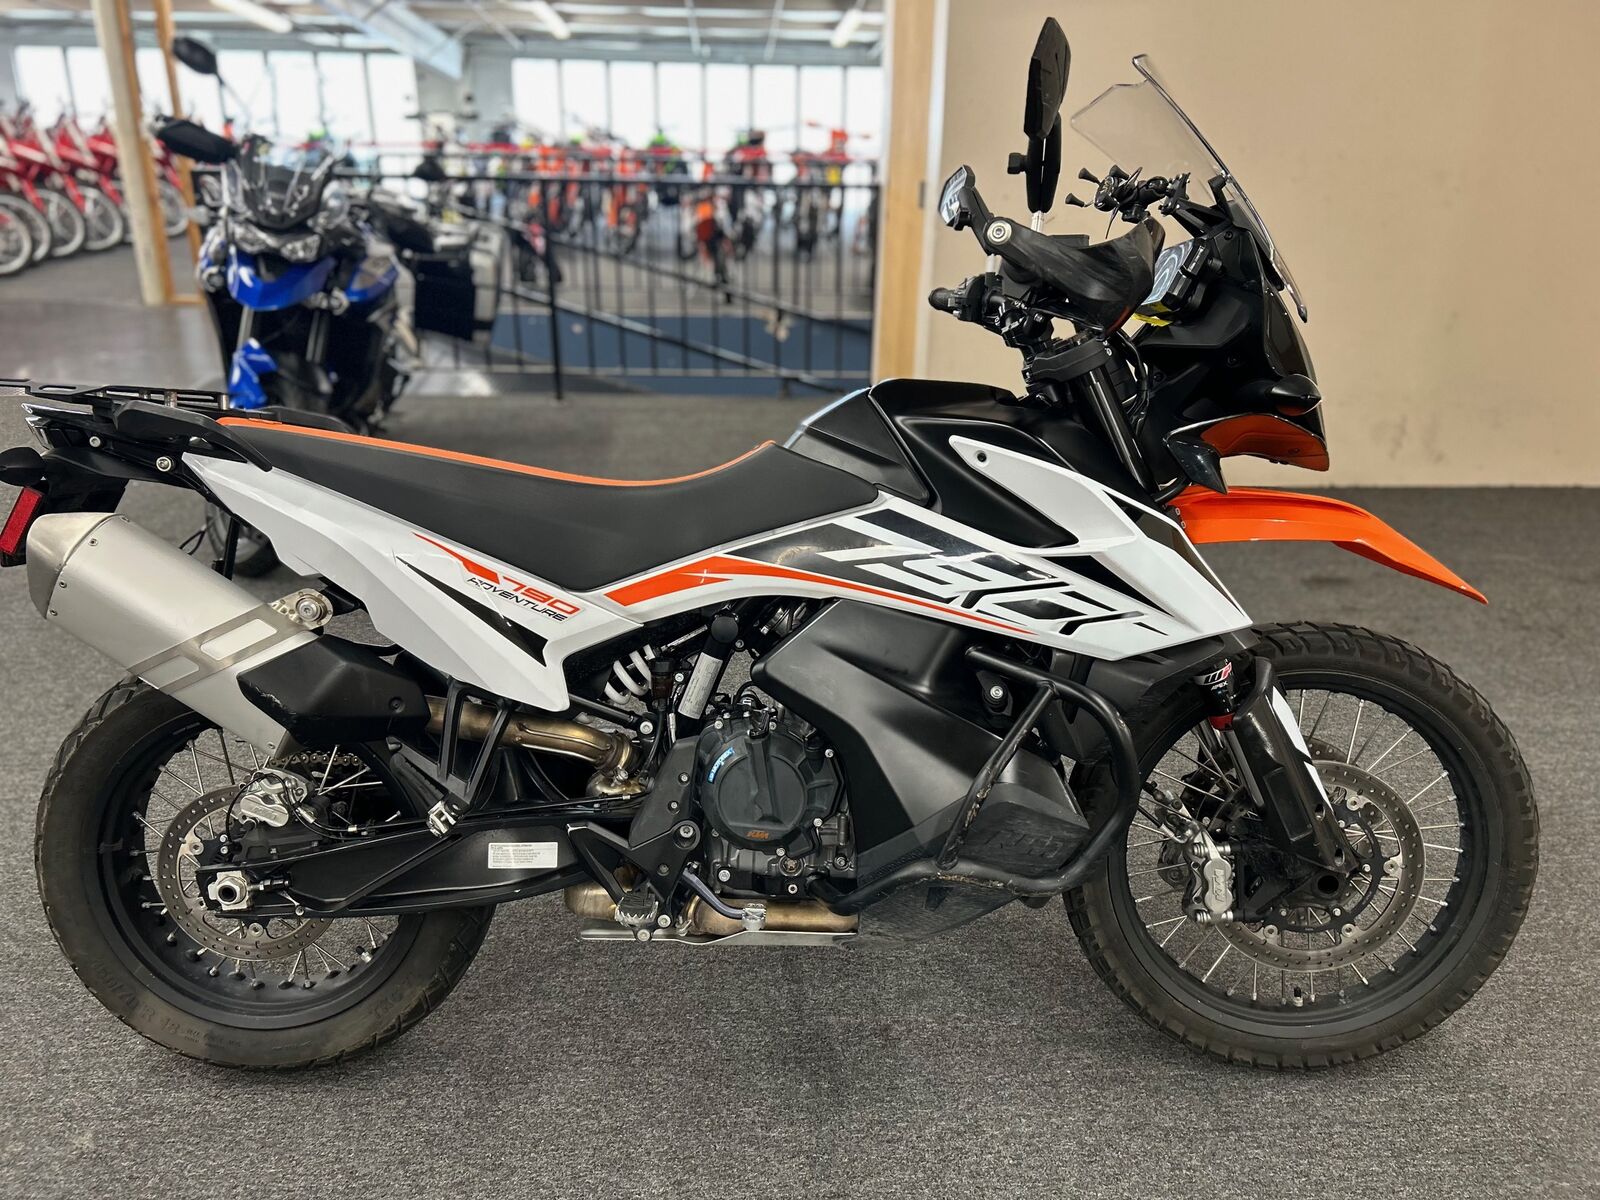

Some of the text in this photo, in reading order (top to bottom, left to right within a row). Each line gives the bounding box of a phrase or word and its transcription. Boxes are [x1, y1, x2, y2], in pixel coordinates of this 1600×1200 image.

[466, 577, 568, 622] ADVENTURE
[503, 575, 581, 615] 790
[1212, 868, 1226, 903] KTM
